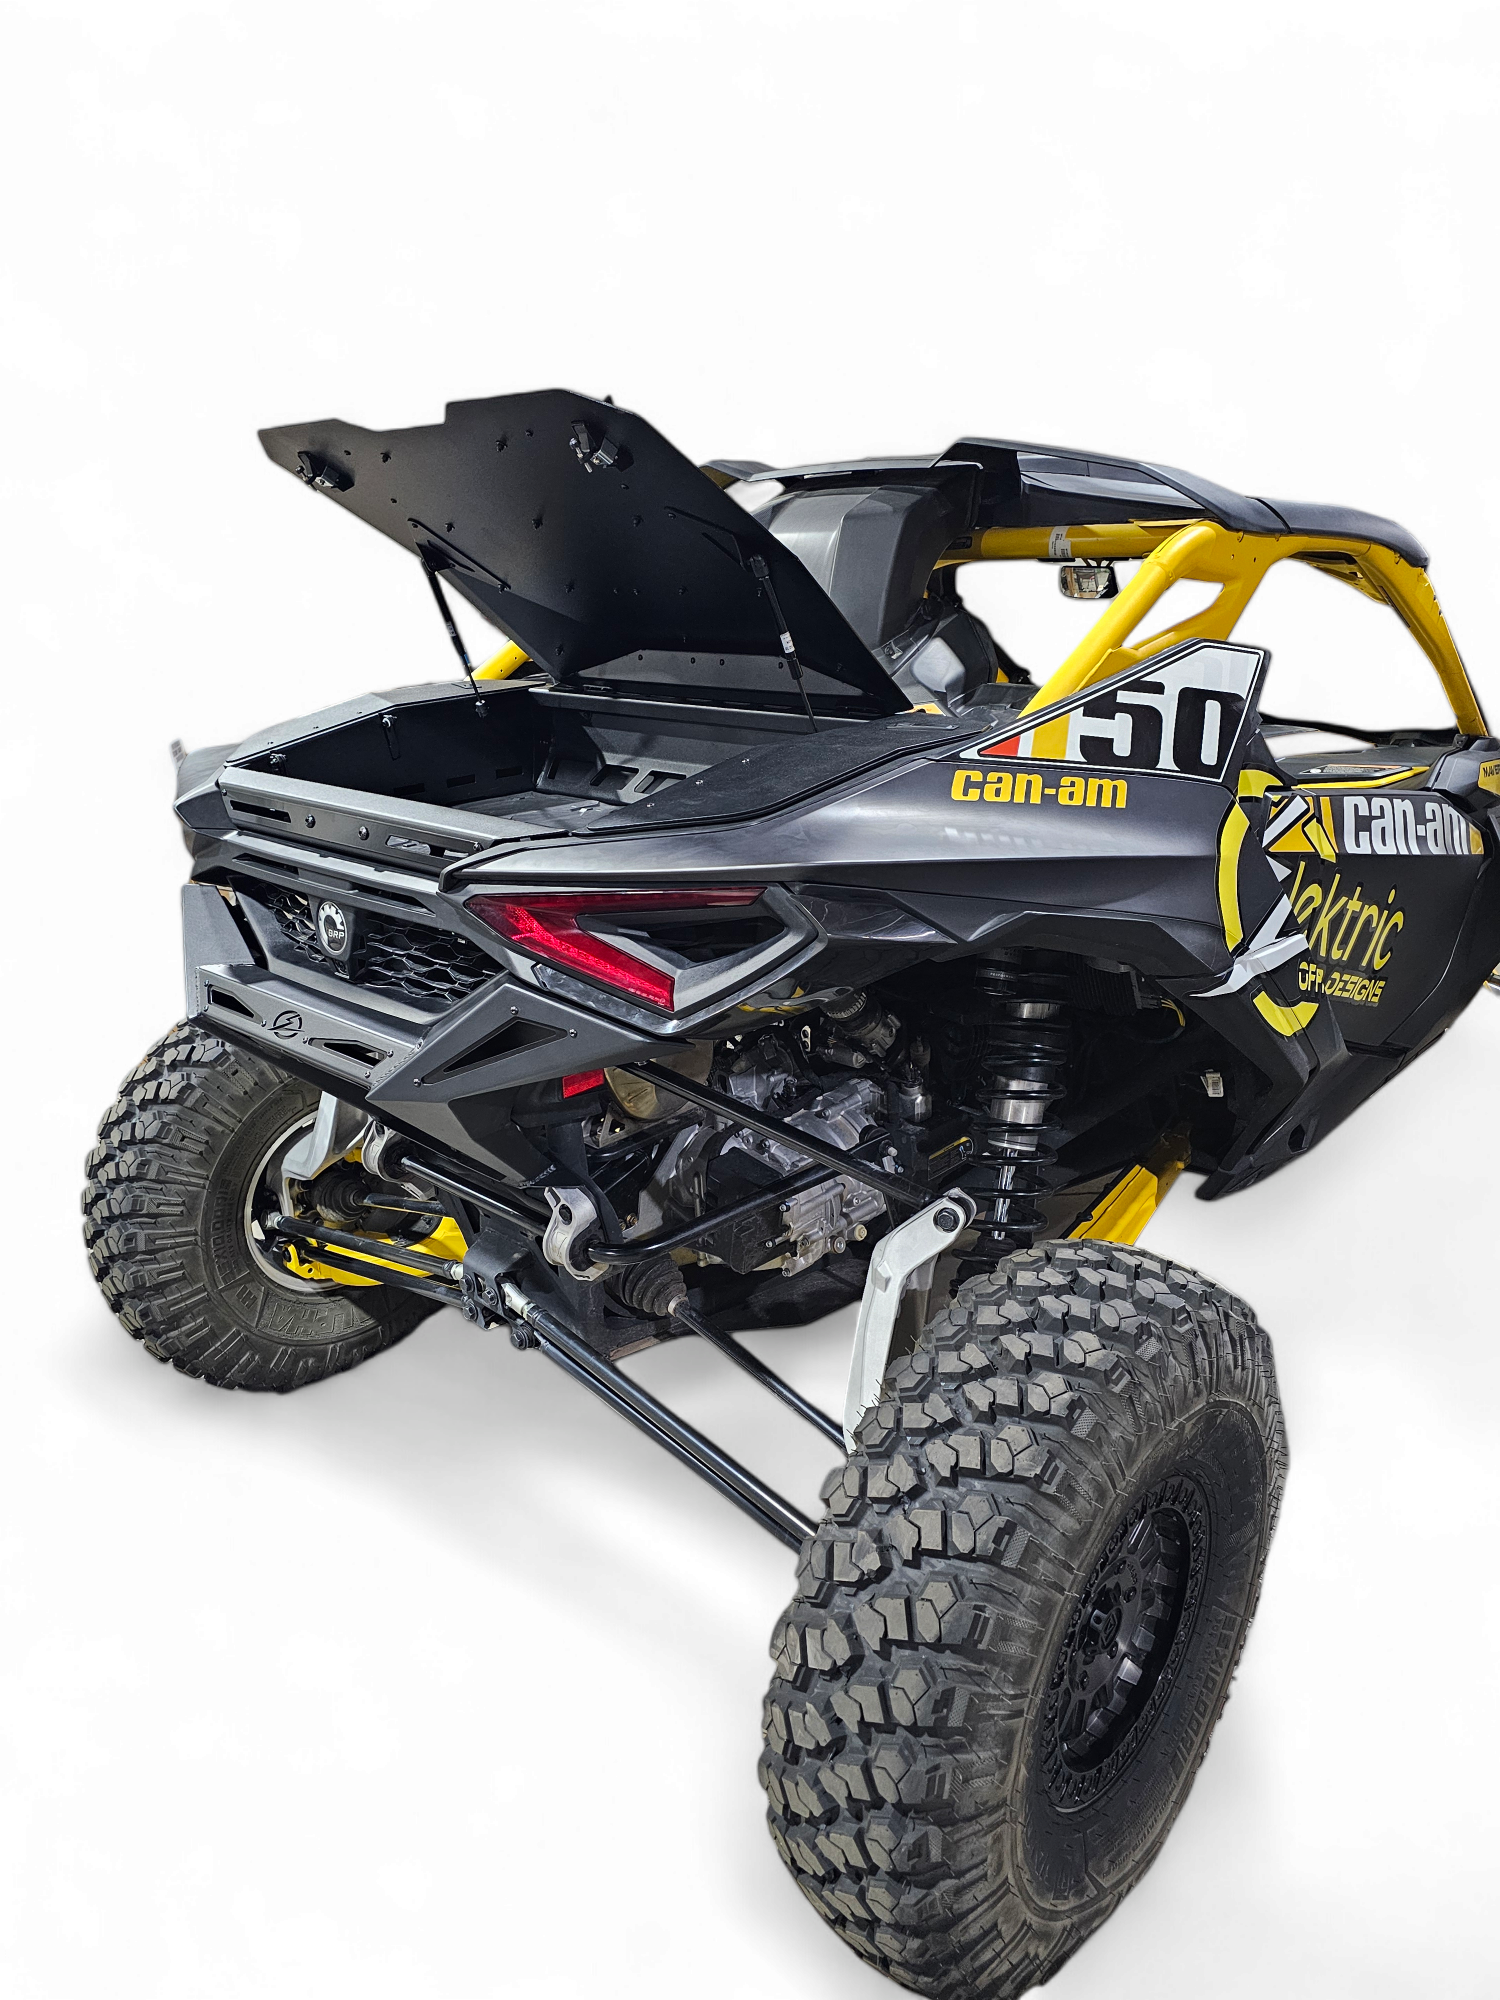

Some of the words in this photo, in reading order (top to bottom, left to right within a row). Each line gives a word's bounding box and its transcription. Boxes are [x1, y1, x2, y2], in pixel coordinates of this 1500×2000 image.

[1079, 680, 1244, 777] 50
[951, 769, 1128, 809] can-am
[1343, 796, 1470, 855] can-am
[328, 929, 345, 939] BRP
[1325, 971, 1386, 1003] DESIGNS
